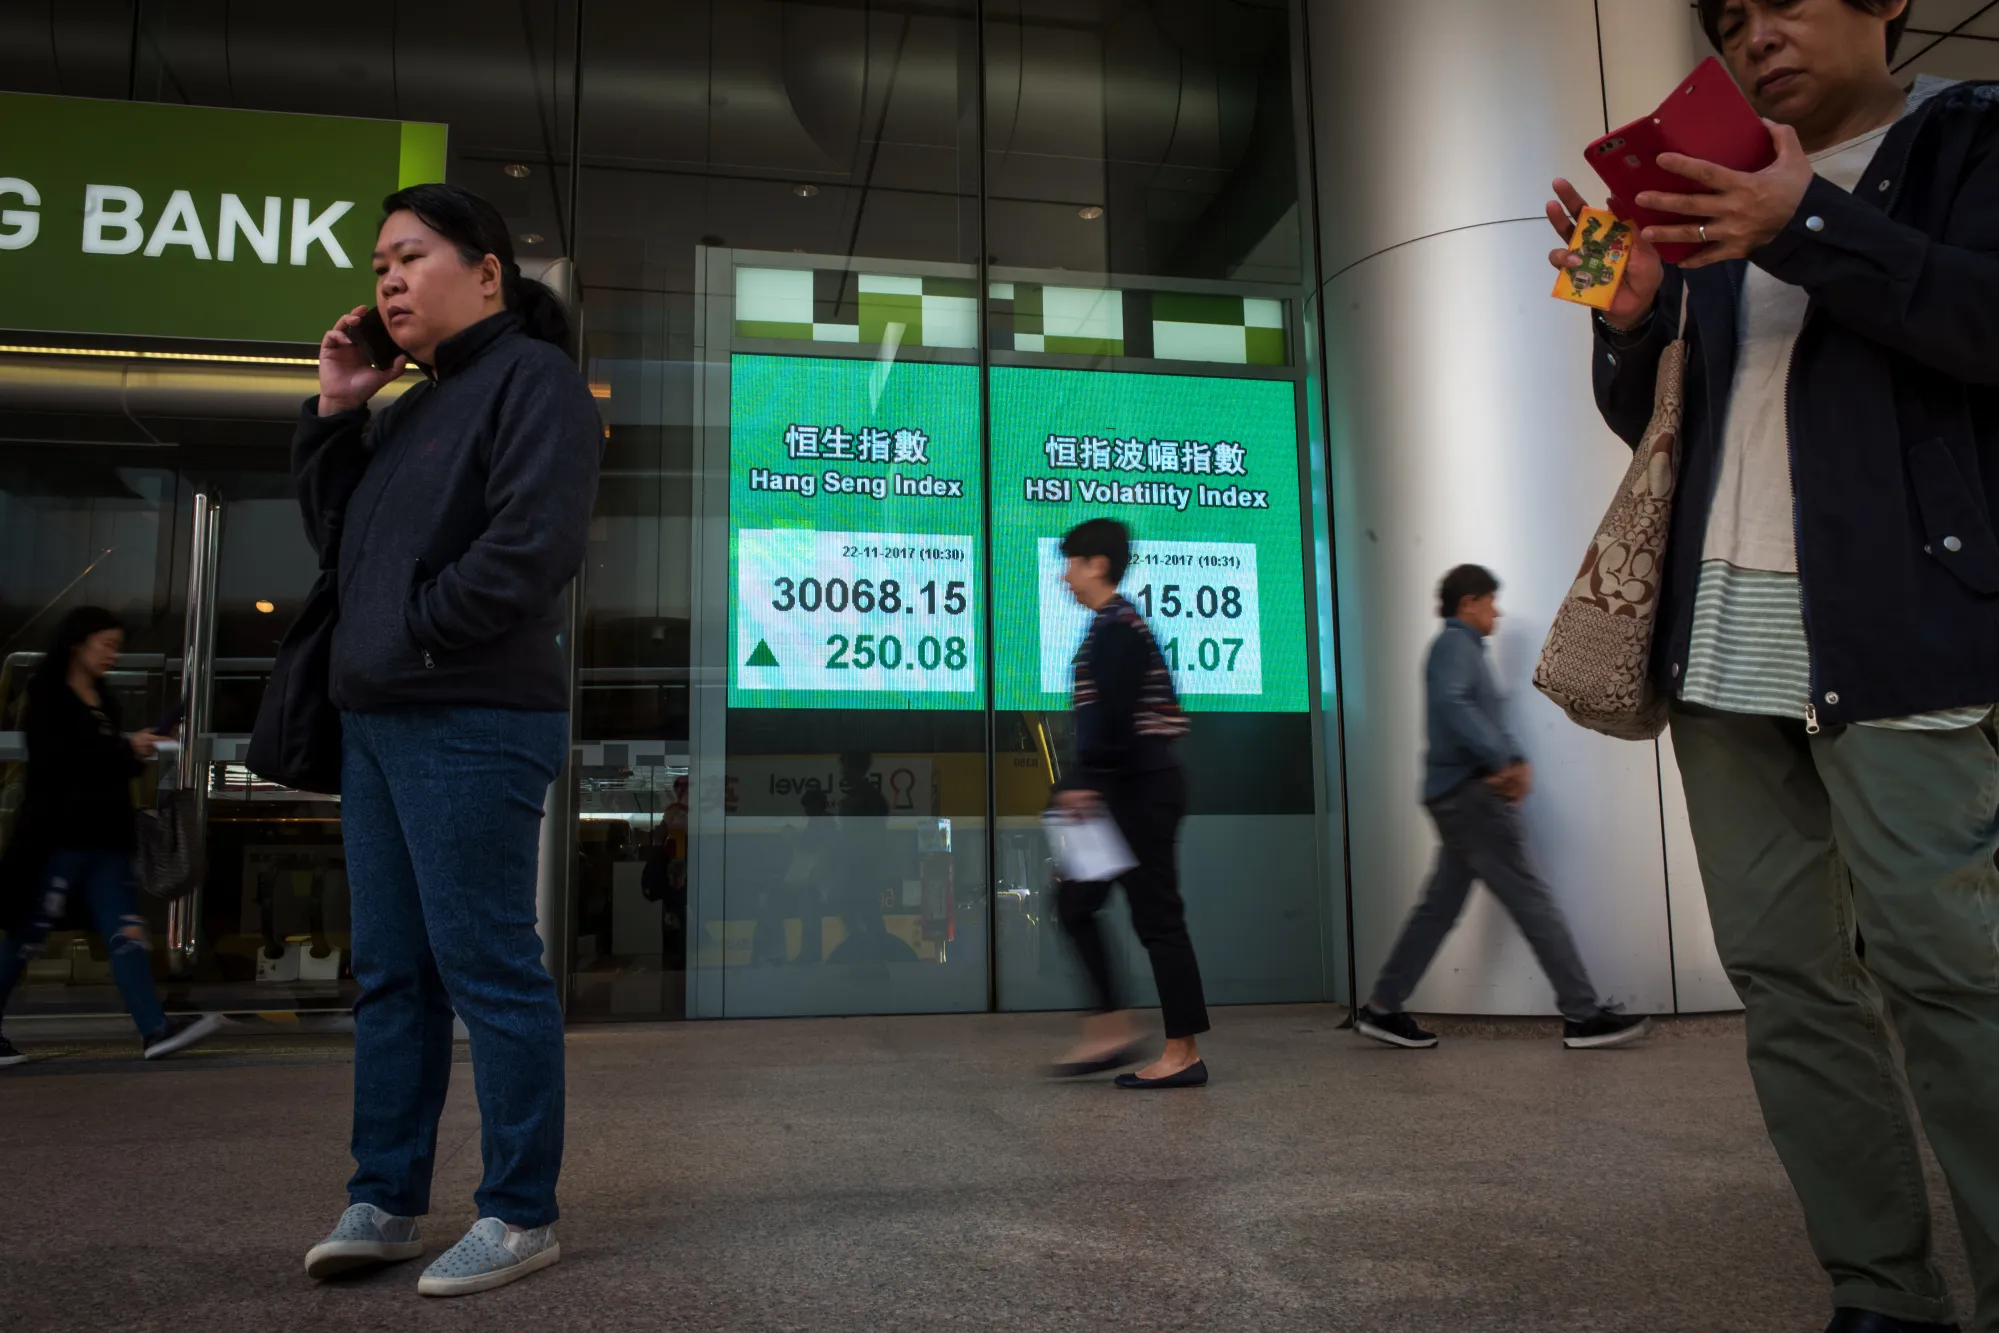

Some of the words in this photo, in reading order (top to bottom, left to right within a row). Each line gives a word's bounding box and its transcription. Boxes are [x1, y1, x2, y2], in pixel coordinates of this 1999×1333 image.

[82, 184, 355, 269] BANK
[785, 424, 929, 464] 恒生指數
[1045, 434, 1247, 476] 恒指波幅指數
[750, 468, 817, 497] Hang
[823, 471, 888, 499] Seng
[894, 473, 963, 497] Index
[1025, 477, 1071, 502] HSI
[1077, 479, 1191, 511] Volatility
[1198, 484, 1269, 509] Index
[843, 546, 915, 559] 22-11-2017
[920, 548, 965, 562] (10:30)
[1199, 555, 1241, 569] (10:31)
[772, 577, 967, 615] 30068.15
[1138, 584, 1242, 618] 15.08
[826, 634, 967, 670] 250.08
[1164, 637, 1244, 671] 1.07
